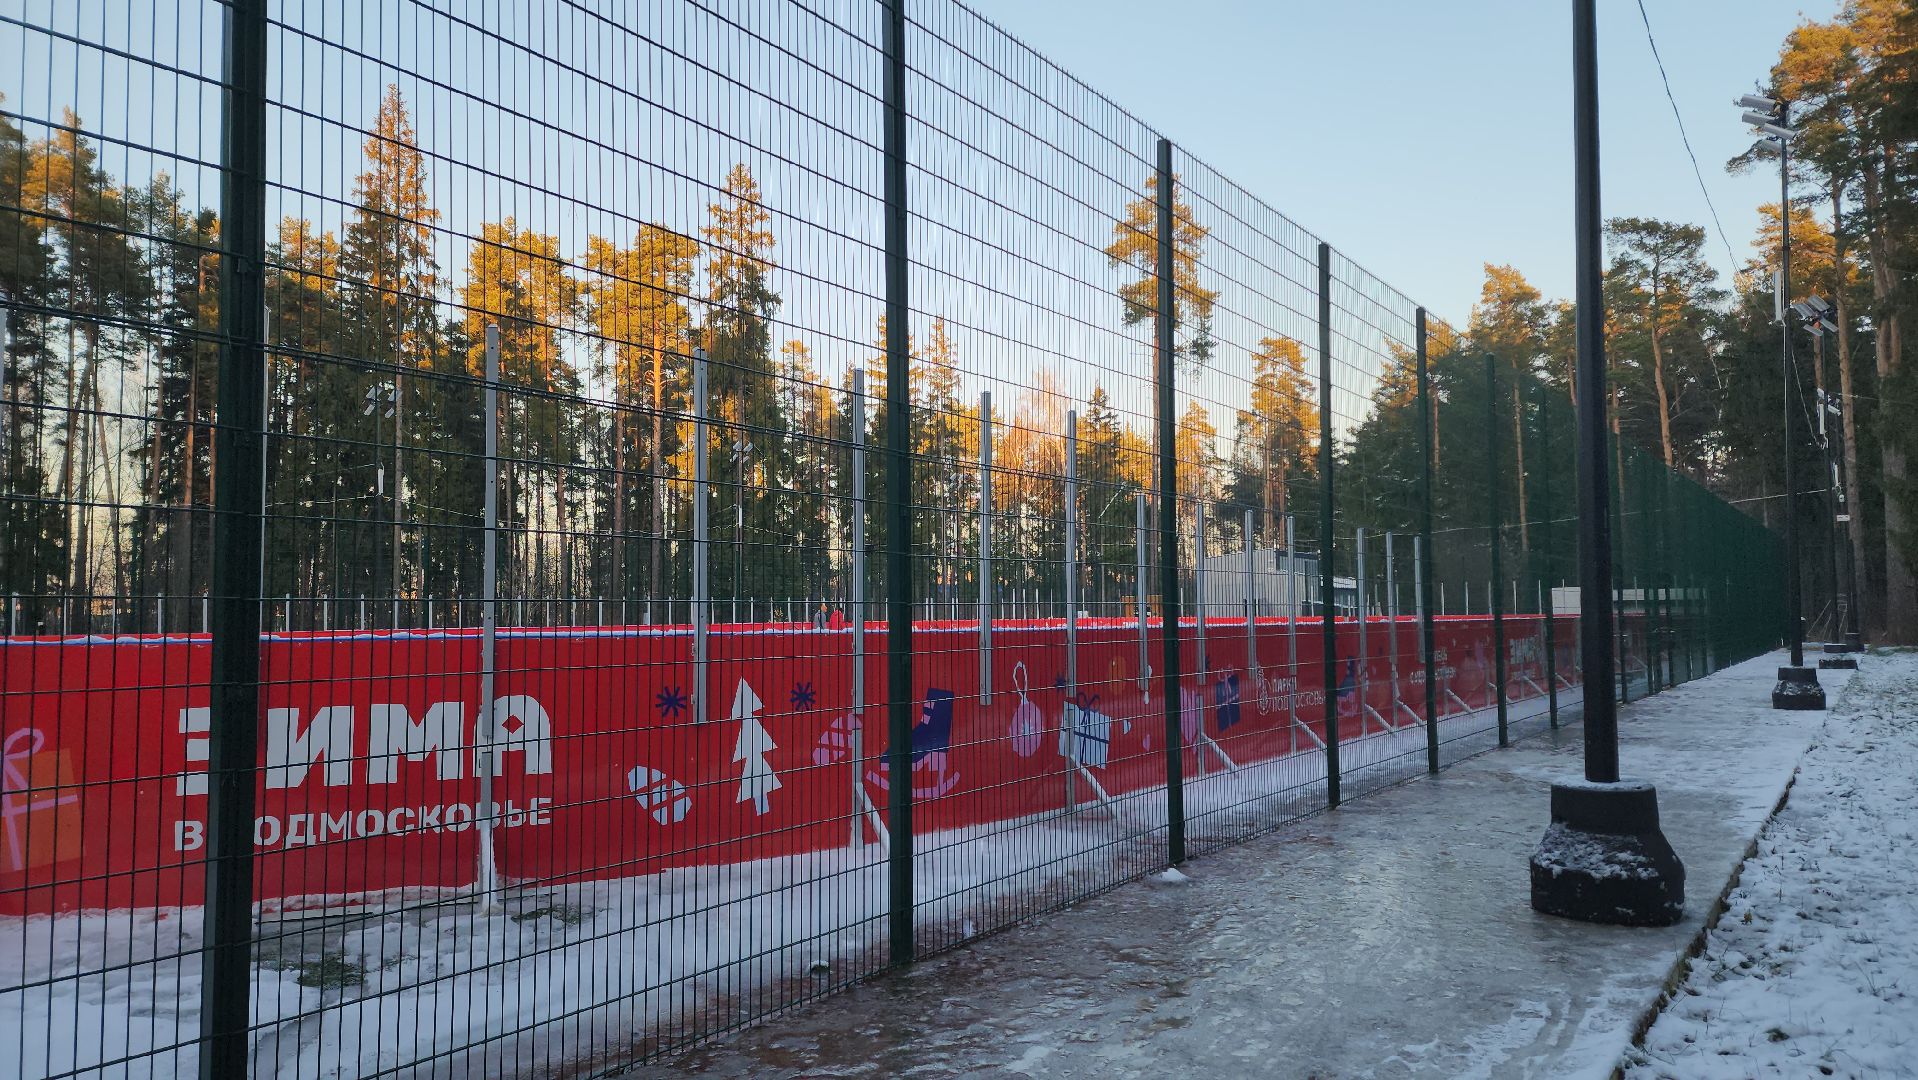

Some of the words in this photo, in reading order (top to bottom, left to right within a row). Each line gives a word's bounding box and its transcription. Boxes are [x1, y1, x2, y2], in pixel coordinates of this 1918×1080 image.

[1272, 690, 1326, 712] ПОДОСКОВЬ
[175, 820, 204, 851] В
[253, 797, 552, 850] ОДМОСКОВЬЕ
